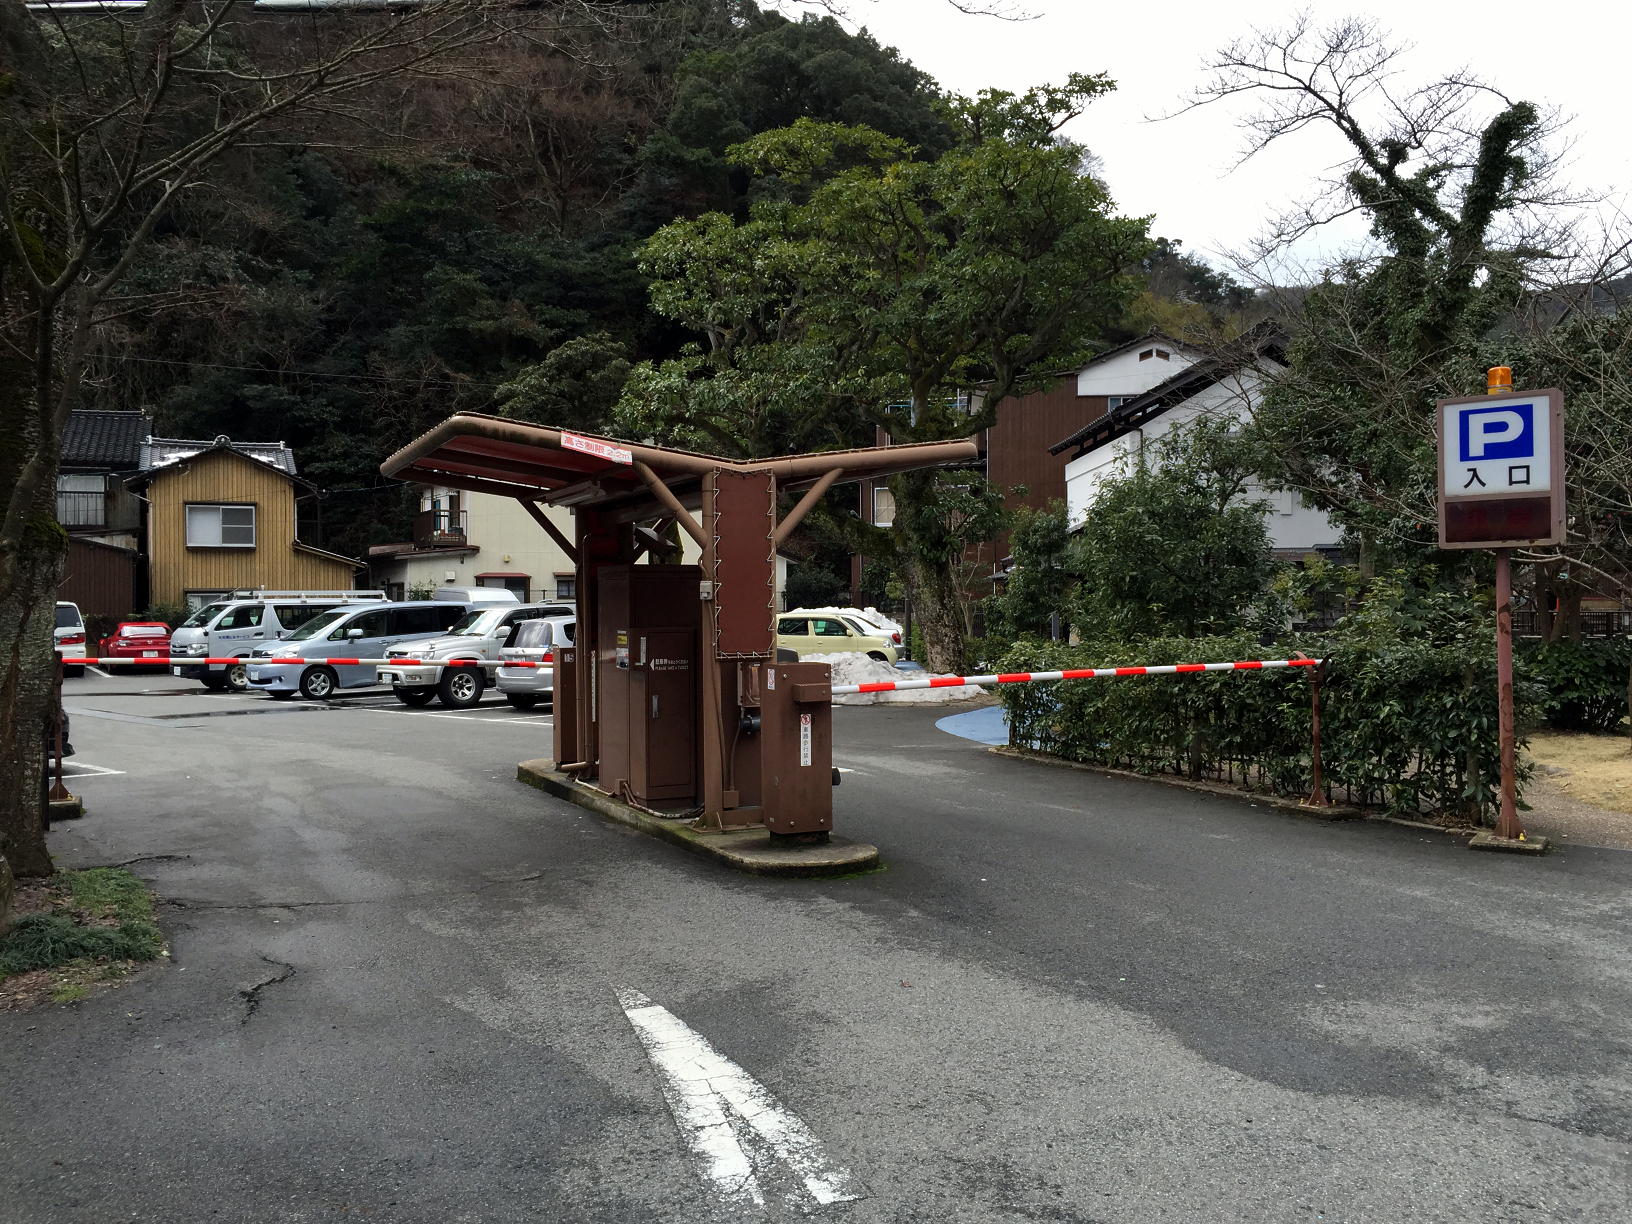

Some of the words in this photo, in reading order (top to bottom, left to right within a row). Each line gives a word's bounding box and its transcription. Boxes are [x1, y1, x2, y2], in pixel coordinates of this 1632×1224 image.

[564, 435, 605, 454] 高さ制限
[1469, 410, 1524, 457] P
[1463, 465, 1531, 489] 入口
